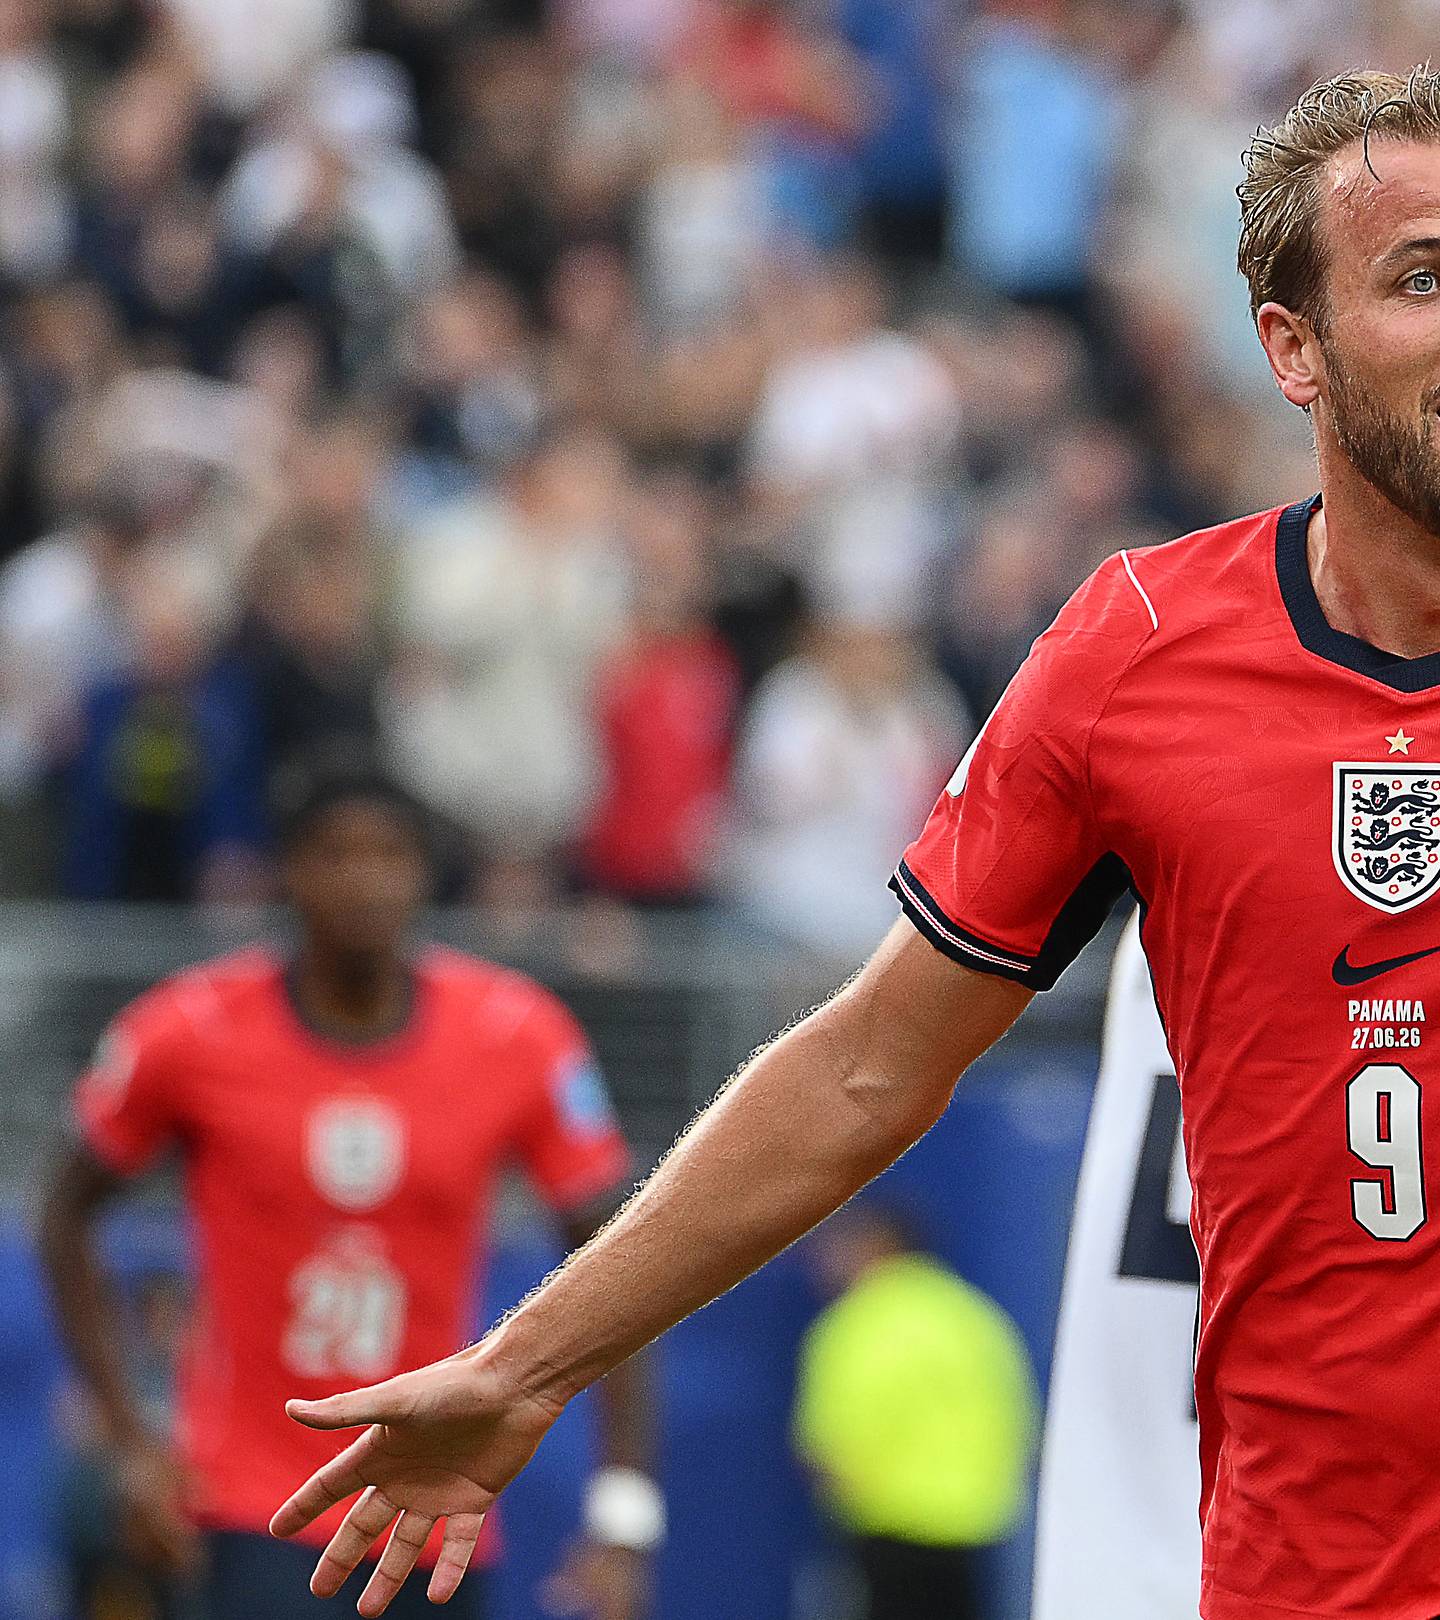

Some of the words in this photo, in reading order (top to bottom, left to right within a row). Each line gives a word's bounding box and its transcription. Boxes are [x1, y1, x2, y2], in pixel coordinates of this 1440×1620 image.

[1348, 1000, 1426, 1022] PANAMA
[1351, 1028, 1421, 1049] 27.06.26
[1346, 1062, 1428, 1241] 9
